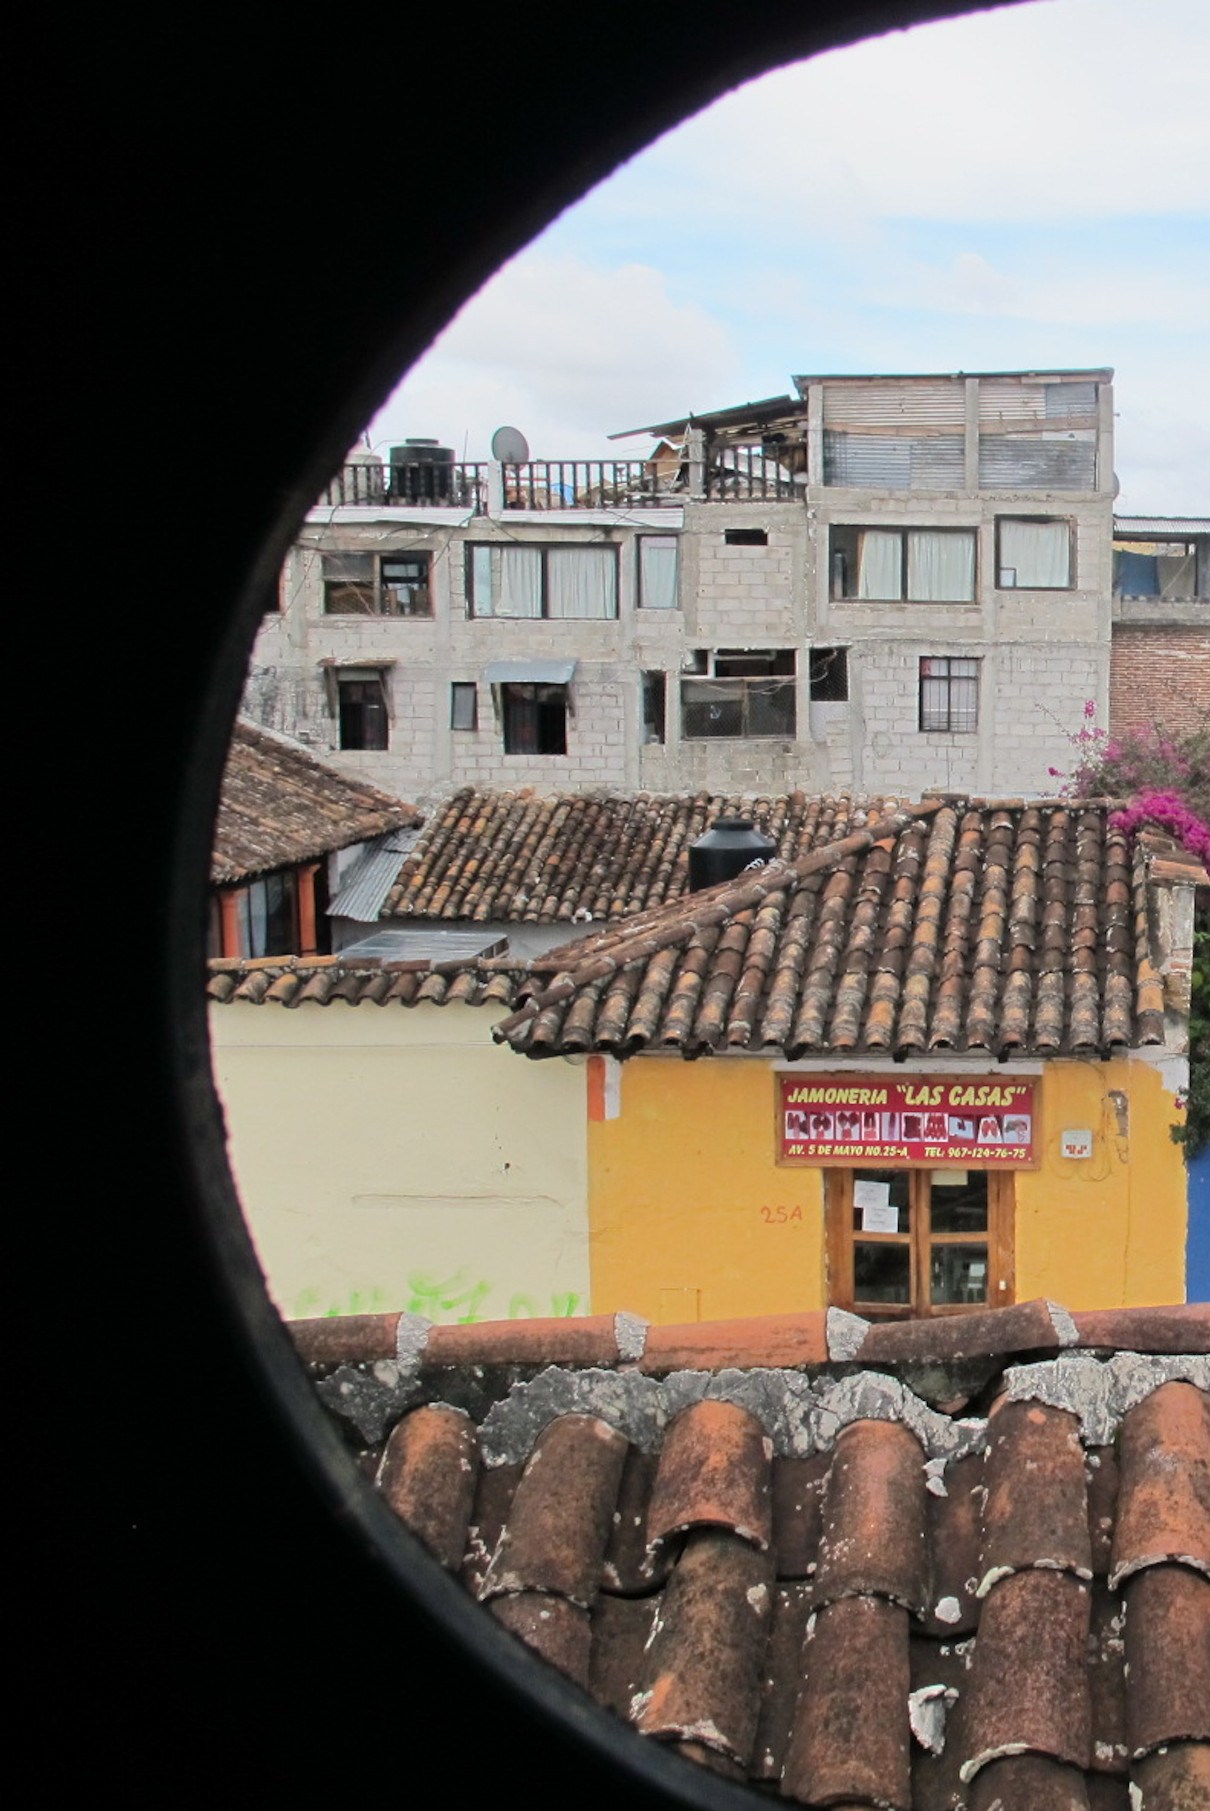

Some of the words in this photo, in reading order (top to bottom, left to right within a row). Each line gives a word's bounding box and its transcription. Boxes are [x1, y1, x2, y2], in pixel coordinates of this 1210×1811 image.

[787, 1087, 888, 1105] JAMONERIA
[895, 1084, 945, 1106] "LAS
[948, 1085, 1027, 1106] CASAS"
[788, 1144, 805, 1155] AV.
[808, 1144, 816, 1155] 5
[817, 1144, 833, 1156] DE
[833, 1145, 864, 1156] MAYO
[760, 1204, 802, 1223] 25A
